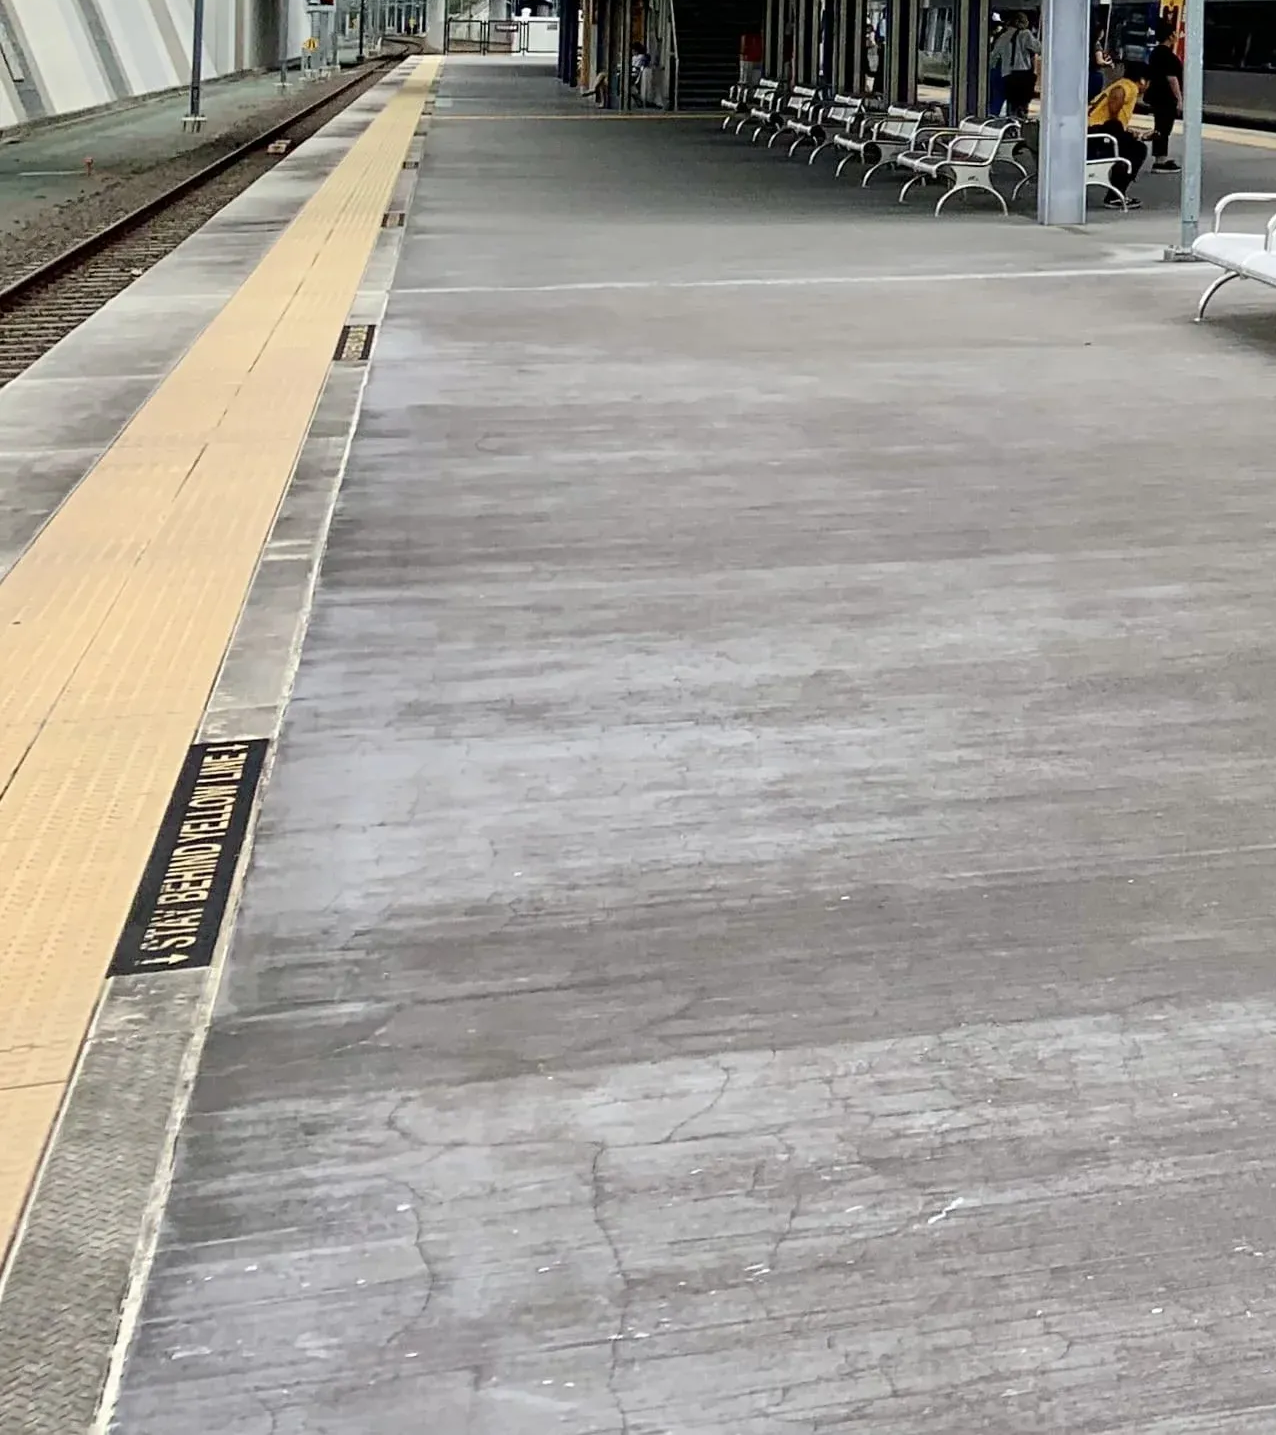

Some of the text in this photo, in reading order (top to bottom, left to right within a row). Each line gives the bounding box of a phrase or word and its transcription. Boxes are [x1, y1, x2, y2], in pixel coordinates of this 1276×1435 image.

[140, 753, 247, 951] STAY BEHIND YELLOW LINE
